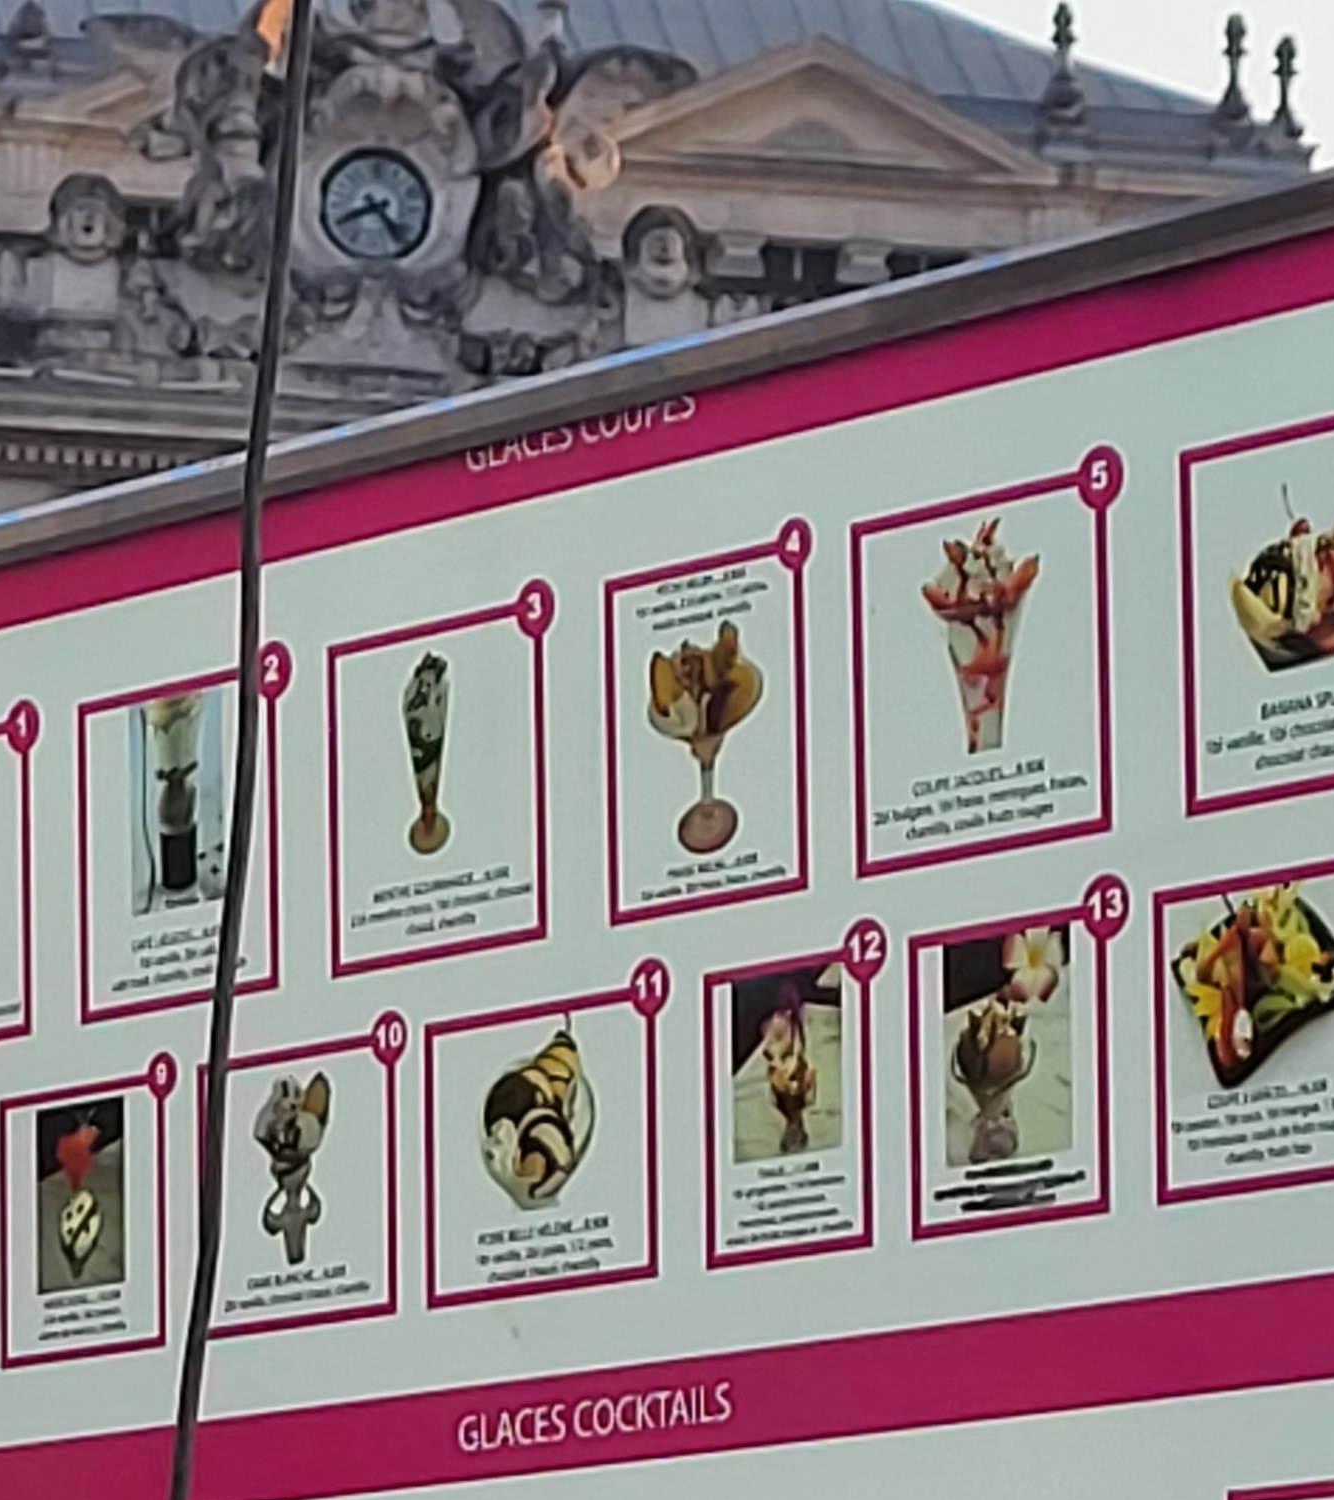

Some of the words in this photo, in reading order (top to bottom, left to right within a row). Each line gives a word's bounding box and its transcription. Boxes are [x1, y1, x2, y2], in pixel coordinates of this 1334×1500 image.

[1090, 459, 1108, 490] 5
[787, 528, 801, 552] 4
[527, 592, 542, 620] 3
[264, 654, 279, 682] 2
[16, 710, 27, 737] 1
[1088, 888, 1123, 920] 13
[848, 931, 881, 962] 12
[636, 970, 663, 999] 11
[376, 1023, 402, 1049] 10
[458, 1404, 566, 1451] GLACES
[573, 1382, 731, 1438] COCKTAILS
